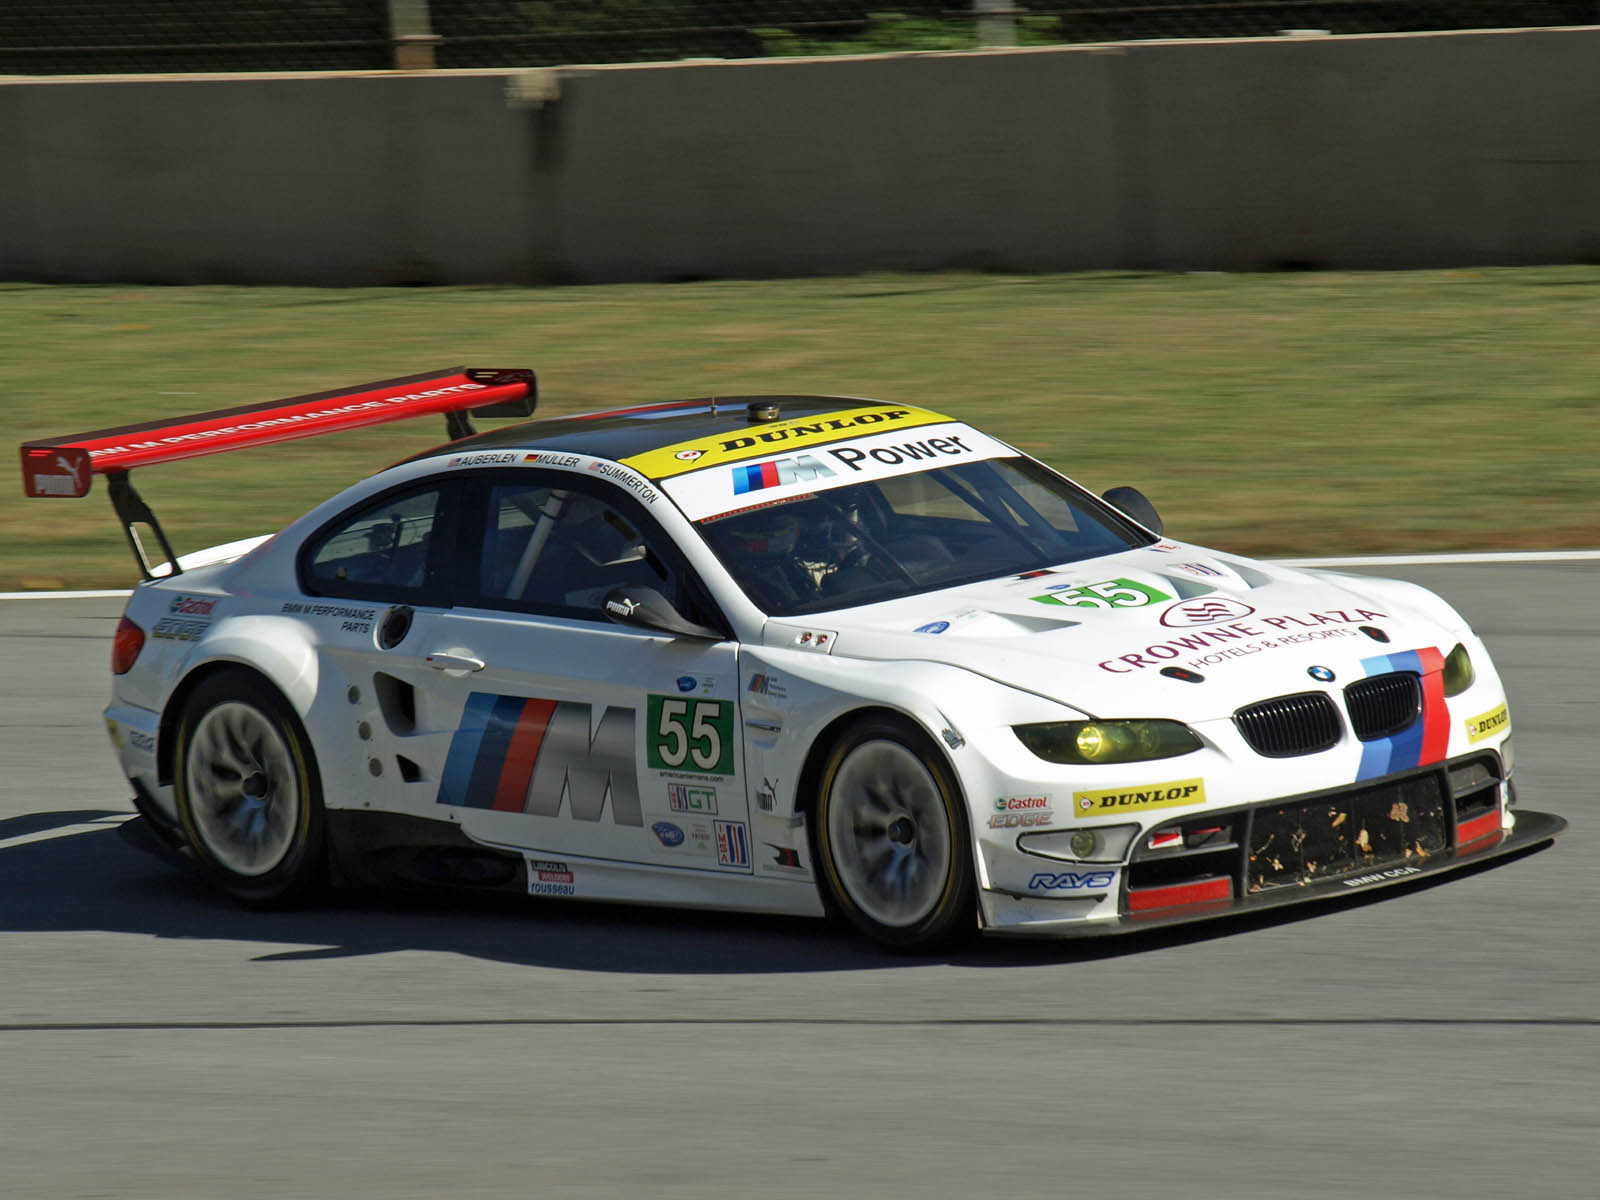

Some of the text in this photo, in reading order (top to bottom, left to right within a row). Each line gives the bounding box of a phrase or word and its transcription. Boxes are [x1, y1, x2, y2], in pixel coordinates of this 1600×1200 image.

[128, 441, 165, 449] M
[160, 401, 382, 443] PERFORMANCE
[384, 383, 487, 404] PARTS
[719, 410, 911, 453] DUNLOP
[460, 453, 518, 466] AUBERLEN
[826, 434, 974, 471] Power
[600, 463, 659, 505] SUMMERTON
[1049, 580, 1151, 609] 55
[281, 602, 303, 614] BMW
[311, 604, 376, 621] PERFORMANCE
[606, 600, 630, 617] PUMA
[340, 621, 371, 634] PARTS
[1098, 607, 1389, 674] CROWNE PLAZA
[1188, 627, 1359, 670] HOTELS & RESORTS
[658, 697, 722, 770] 55
[687, 789, 715, 810] GT
[1007, 796, 1049, 810] Castrol
[1098, 785, 1199, 809] DUNLOP
[987, 812, 1055, 829] EDGE
[530, 882, 576, 896] rousseau
[1028, 871, 1116, 890] RAYS
[1344, 873, 1387, 887] BMW
